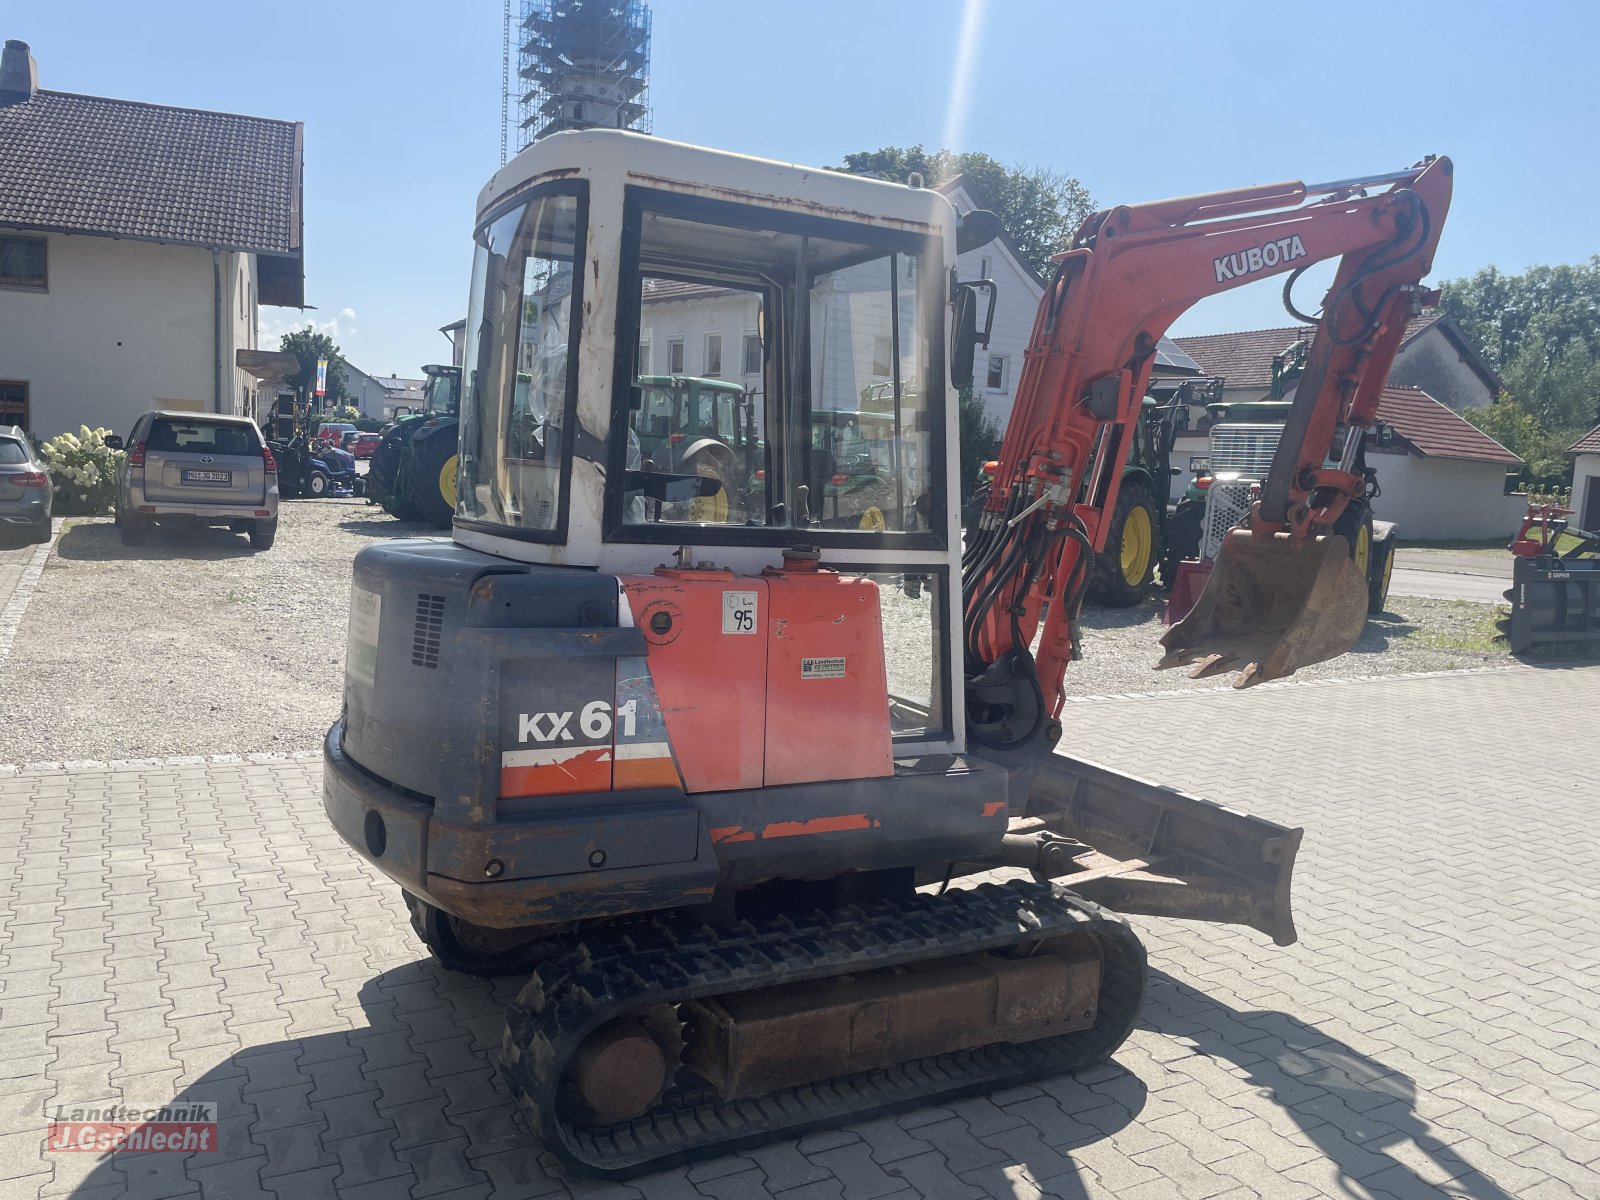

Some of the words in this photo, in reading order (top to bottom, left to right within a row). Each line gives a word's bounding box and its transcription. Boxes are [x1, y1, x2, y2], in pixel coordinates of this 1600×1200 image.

[1214, 234, 1307, 283] KUBOTA
[211, 472, 228, 480] 2023
[734, 609, 753, 631] 95
